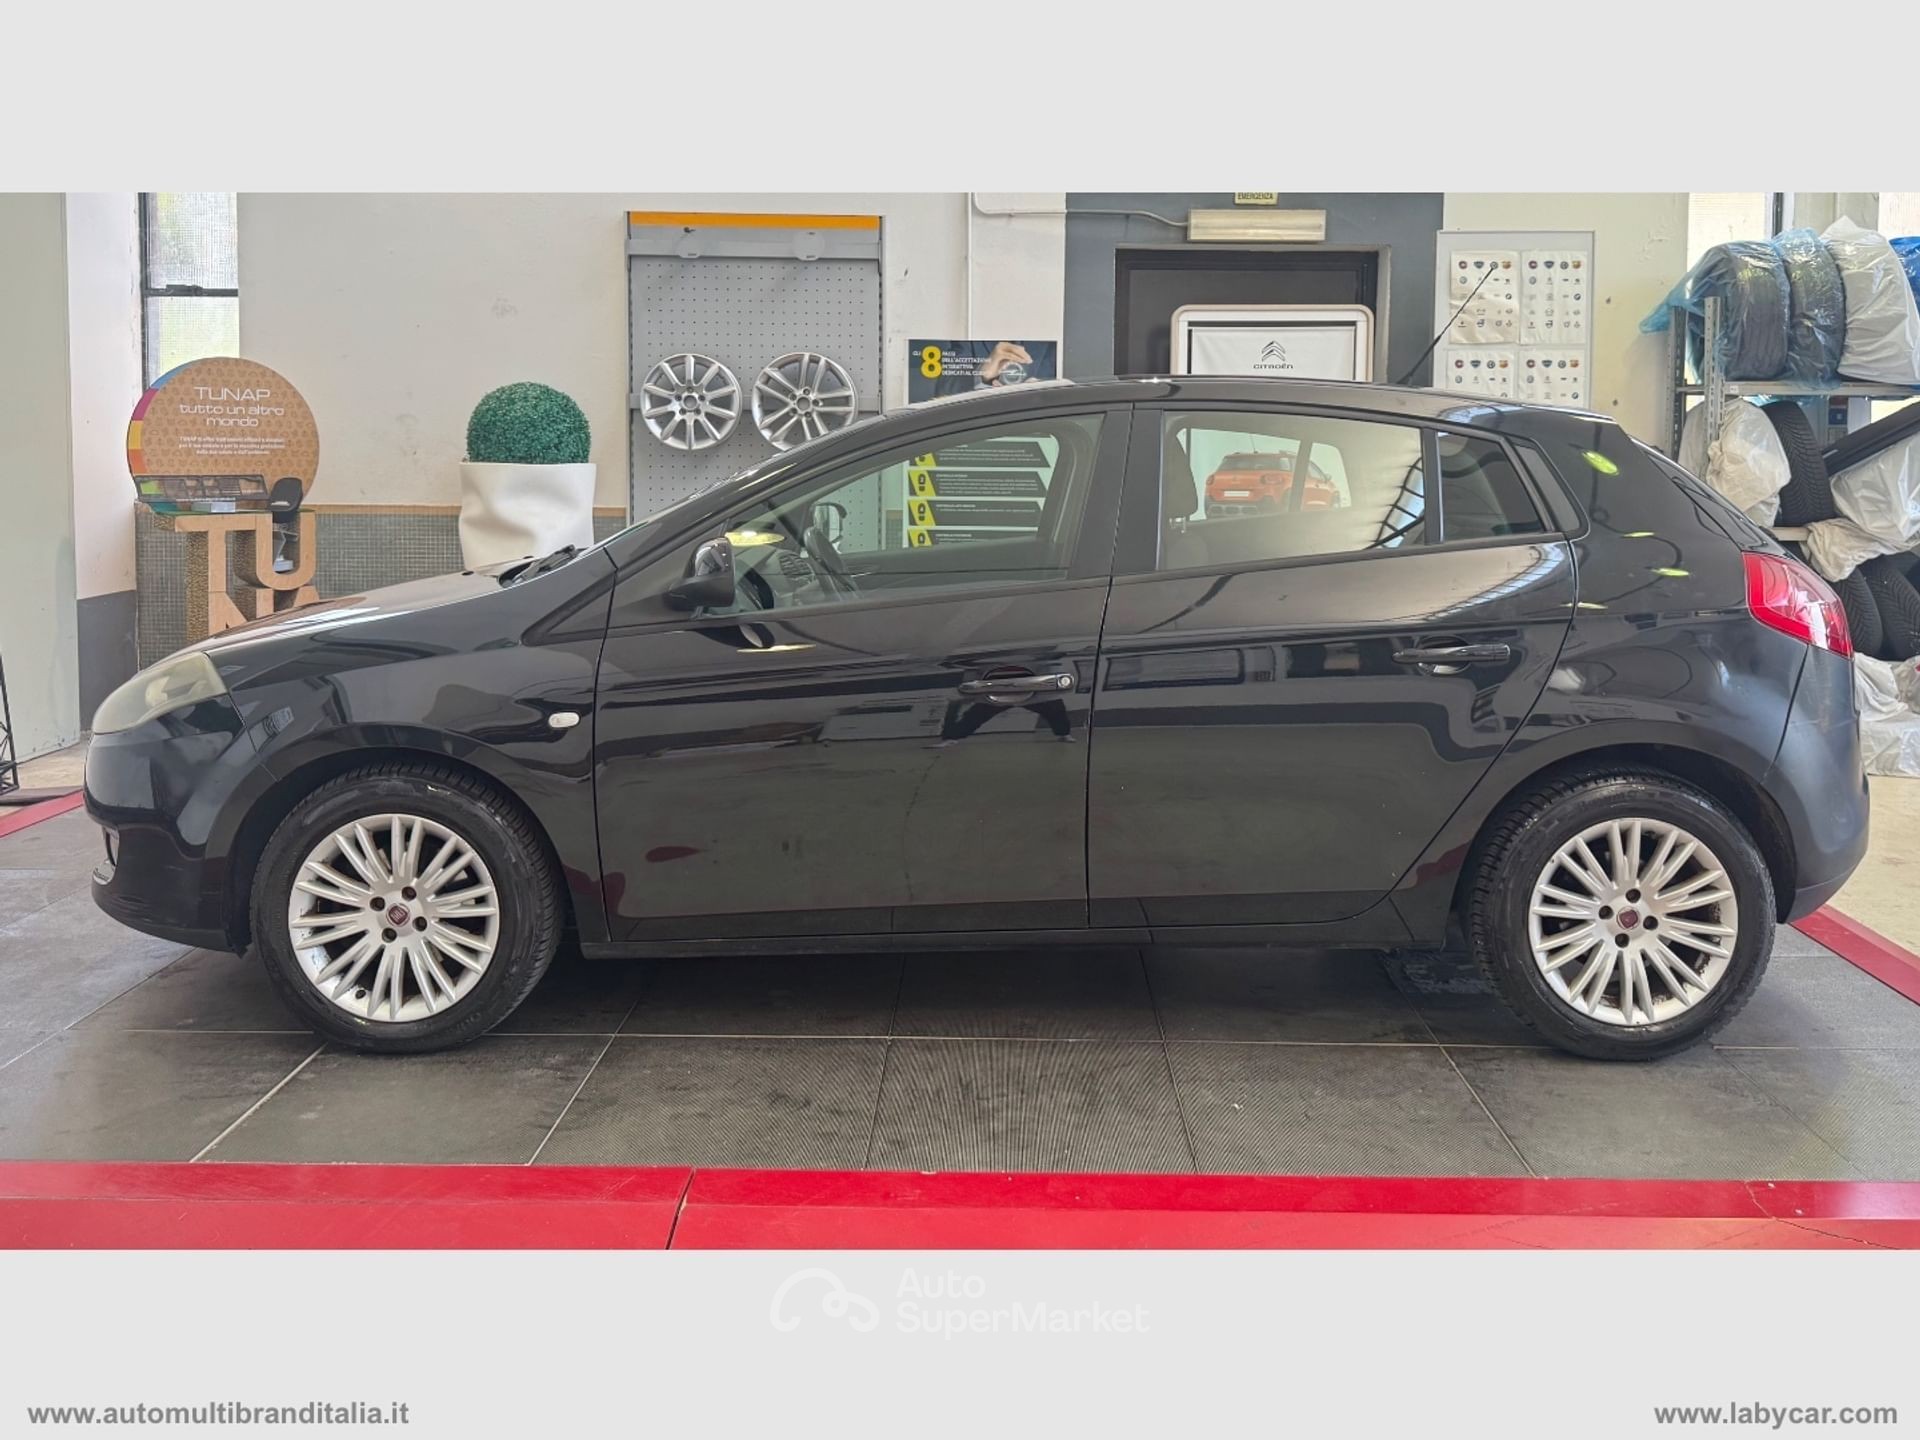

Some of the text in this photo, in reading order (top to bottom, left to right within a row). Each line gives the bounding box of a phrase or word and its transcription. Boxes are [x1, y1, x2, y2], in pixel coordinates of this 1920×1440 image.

[921, 345, 942, 378] 8
[193, 386, 271, 401] TUNAP
[179, 403, 285, 416] tutto un altro
[206, 416, 259, 427] mondo
